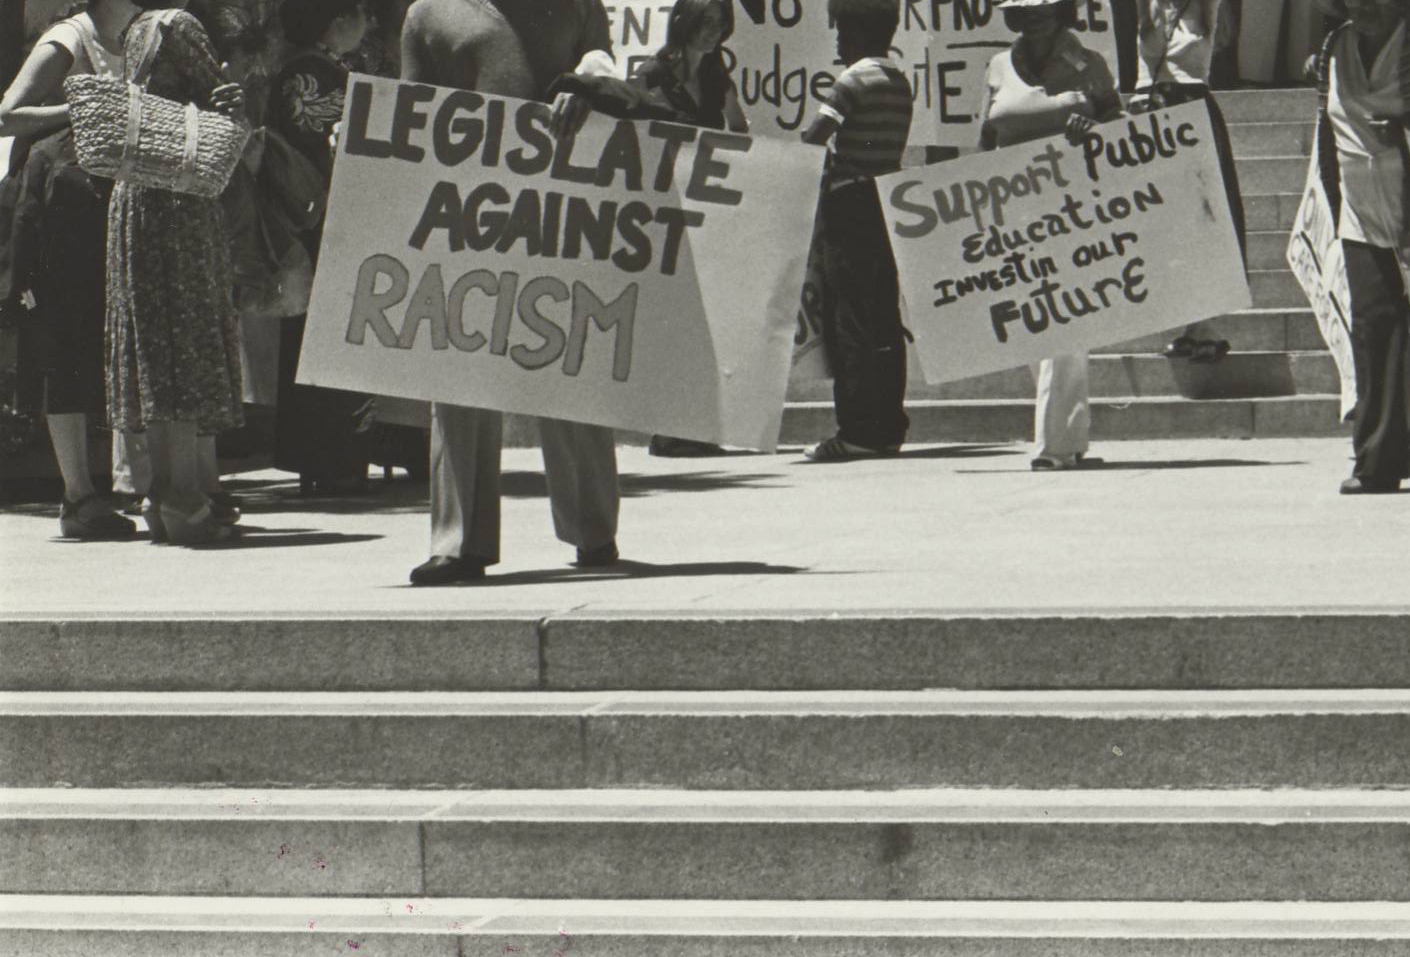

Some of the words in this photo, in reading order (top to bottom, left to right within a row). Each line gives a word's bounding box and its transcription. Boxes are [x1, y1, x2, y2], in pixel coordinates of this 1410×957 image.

[344, 82, 754, 206] LEGISLATE
[890, 143, 1070, 239] Support
[1083, 112, 1199, 182] Public
[408, 181, 705, 276] AGAINST
[1072, 231, 1138, 267] our
[345, 253, 639, 383] RACISM
